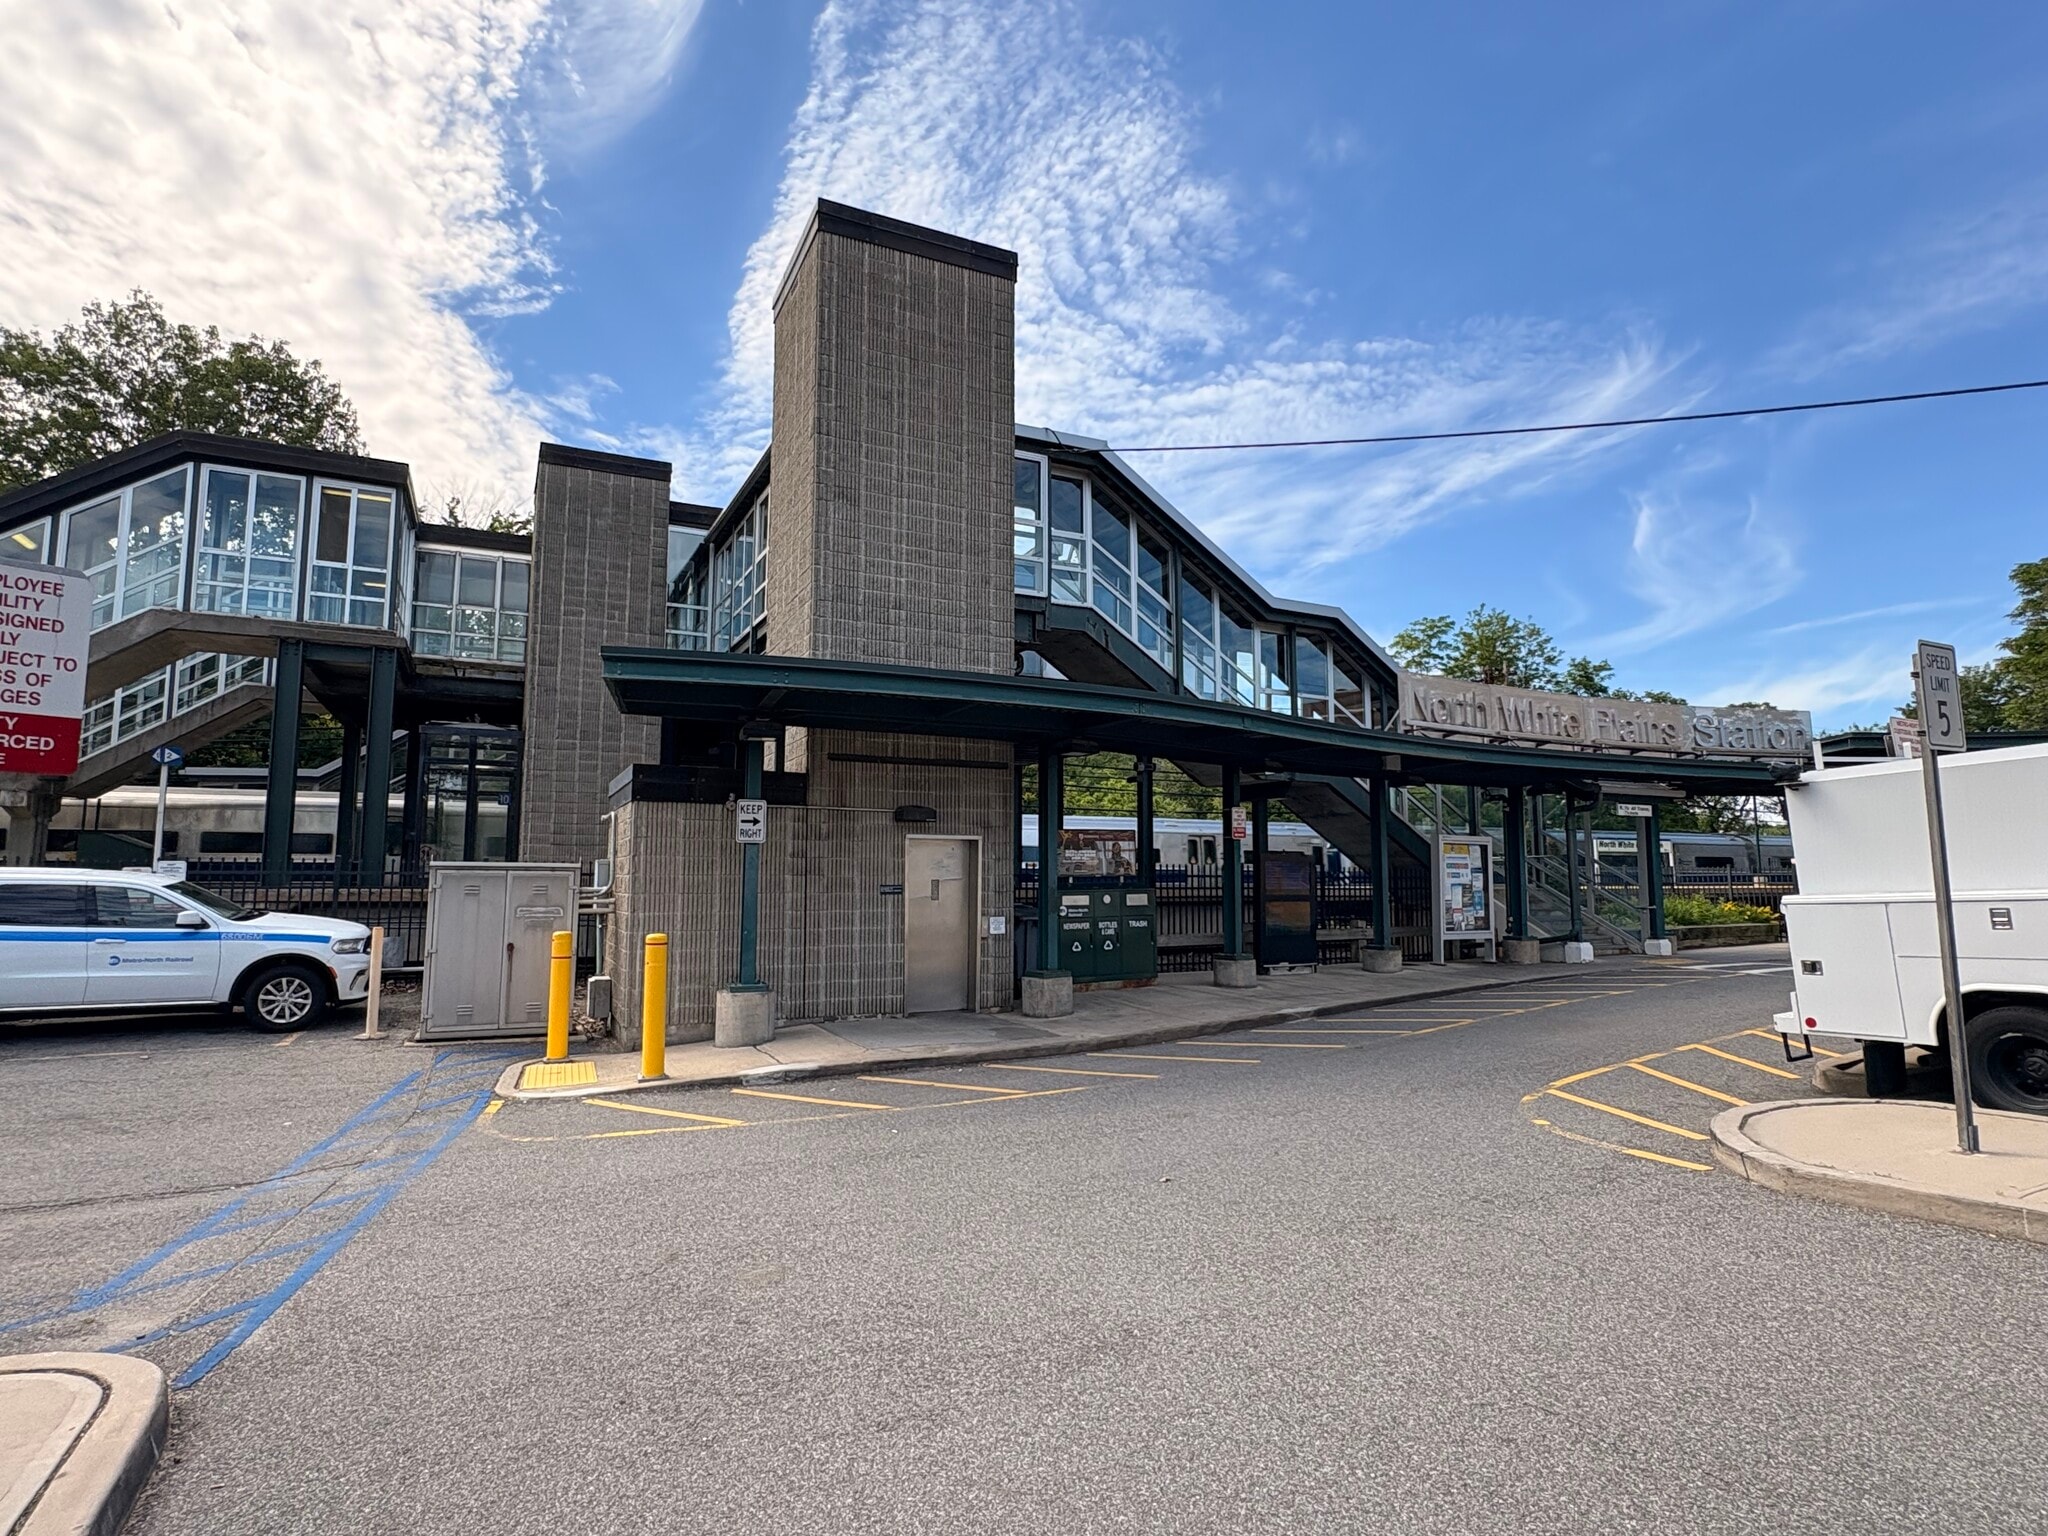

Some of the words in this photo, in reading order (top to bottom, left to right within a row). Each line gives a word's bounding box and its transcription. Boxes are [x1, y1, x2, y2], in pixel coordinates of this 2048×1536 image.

[0, 574, 65, 597] LOYEE
[0, 631, 21, 646] LY
[53, 656, 77, 672] TO
[1926, 653, 1950, 671] SPEED
[25, 672, 52, 687] OF
[1930, 675, 1950, 693] LIMIT
[0, 689, 41, 706] GES
[1412, 689, 1487, 730] North
[1497, 696, 1582, 738] White
[1593, 708, 1678, 746] Plains
[1692, 714, 1807, 750] Station
[1937, 700, 1951, 737] 5
[166, 752, 173, 760] 2
[500, 794, 509, 804] 10
[740, 804, 763, 815] KEEP
[740, 828, 762, 839] RIGHT
[1599, 840, 1616, 848] North
[1617, 841, 1635, 849] White
[1063, 922, 1090, 930] NEWSPAPER
[1098, 921, 1118, 929] BOTTLES
[1128, 920, 1148, 928] TRASH
[122, 956, 164, 964] Metro-North
[165, 955, 194, 963] Railroad
